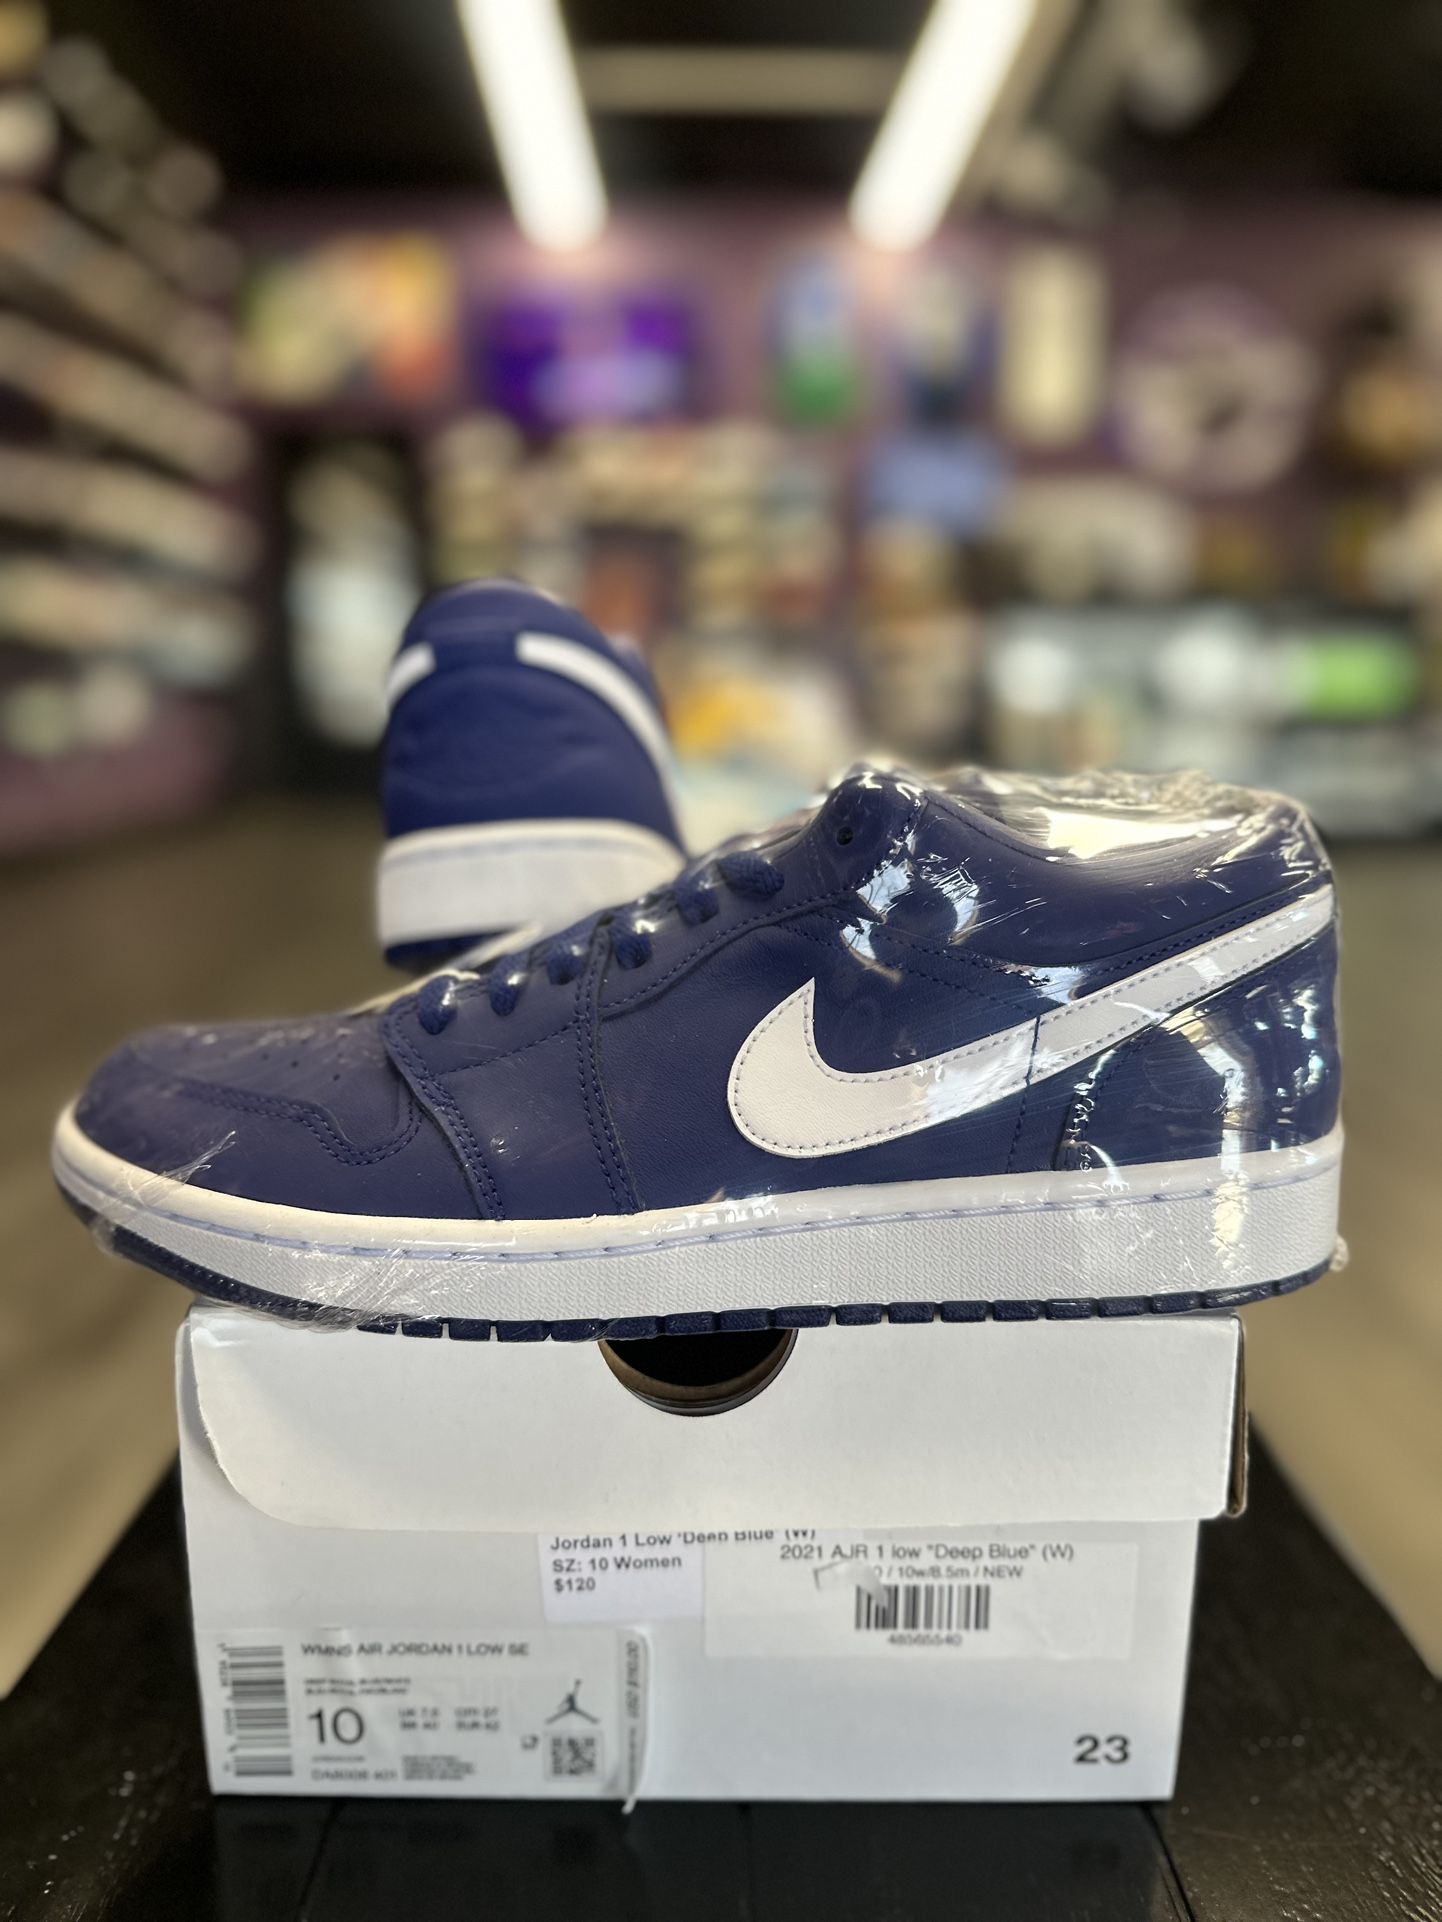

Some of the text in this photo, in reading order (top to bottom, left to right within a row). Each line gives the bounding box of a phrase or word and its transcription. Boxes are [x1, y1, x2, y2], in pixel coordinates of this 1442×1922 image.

[550, 1535, 613, 1550] Jordan
[620, 1534, 627, 1547] 1
[635, 1533, 673, 1546] Low
[780, 1544, 1075, 1563] 2021 AJR 1 low "Deep Blue" (W)
[552, 1555, 683, 1573] SZ: 10 Women
[983, 1565, 1024, 1579] NEW
[554, 1577, 596, 1593] $120
[302, 1643, 530, 1656] WMNS AIR JORDAN 1 LOW SE
[308, 1706, 366, 1746] 10
[1074, 1733, 1131, 1765] 23
